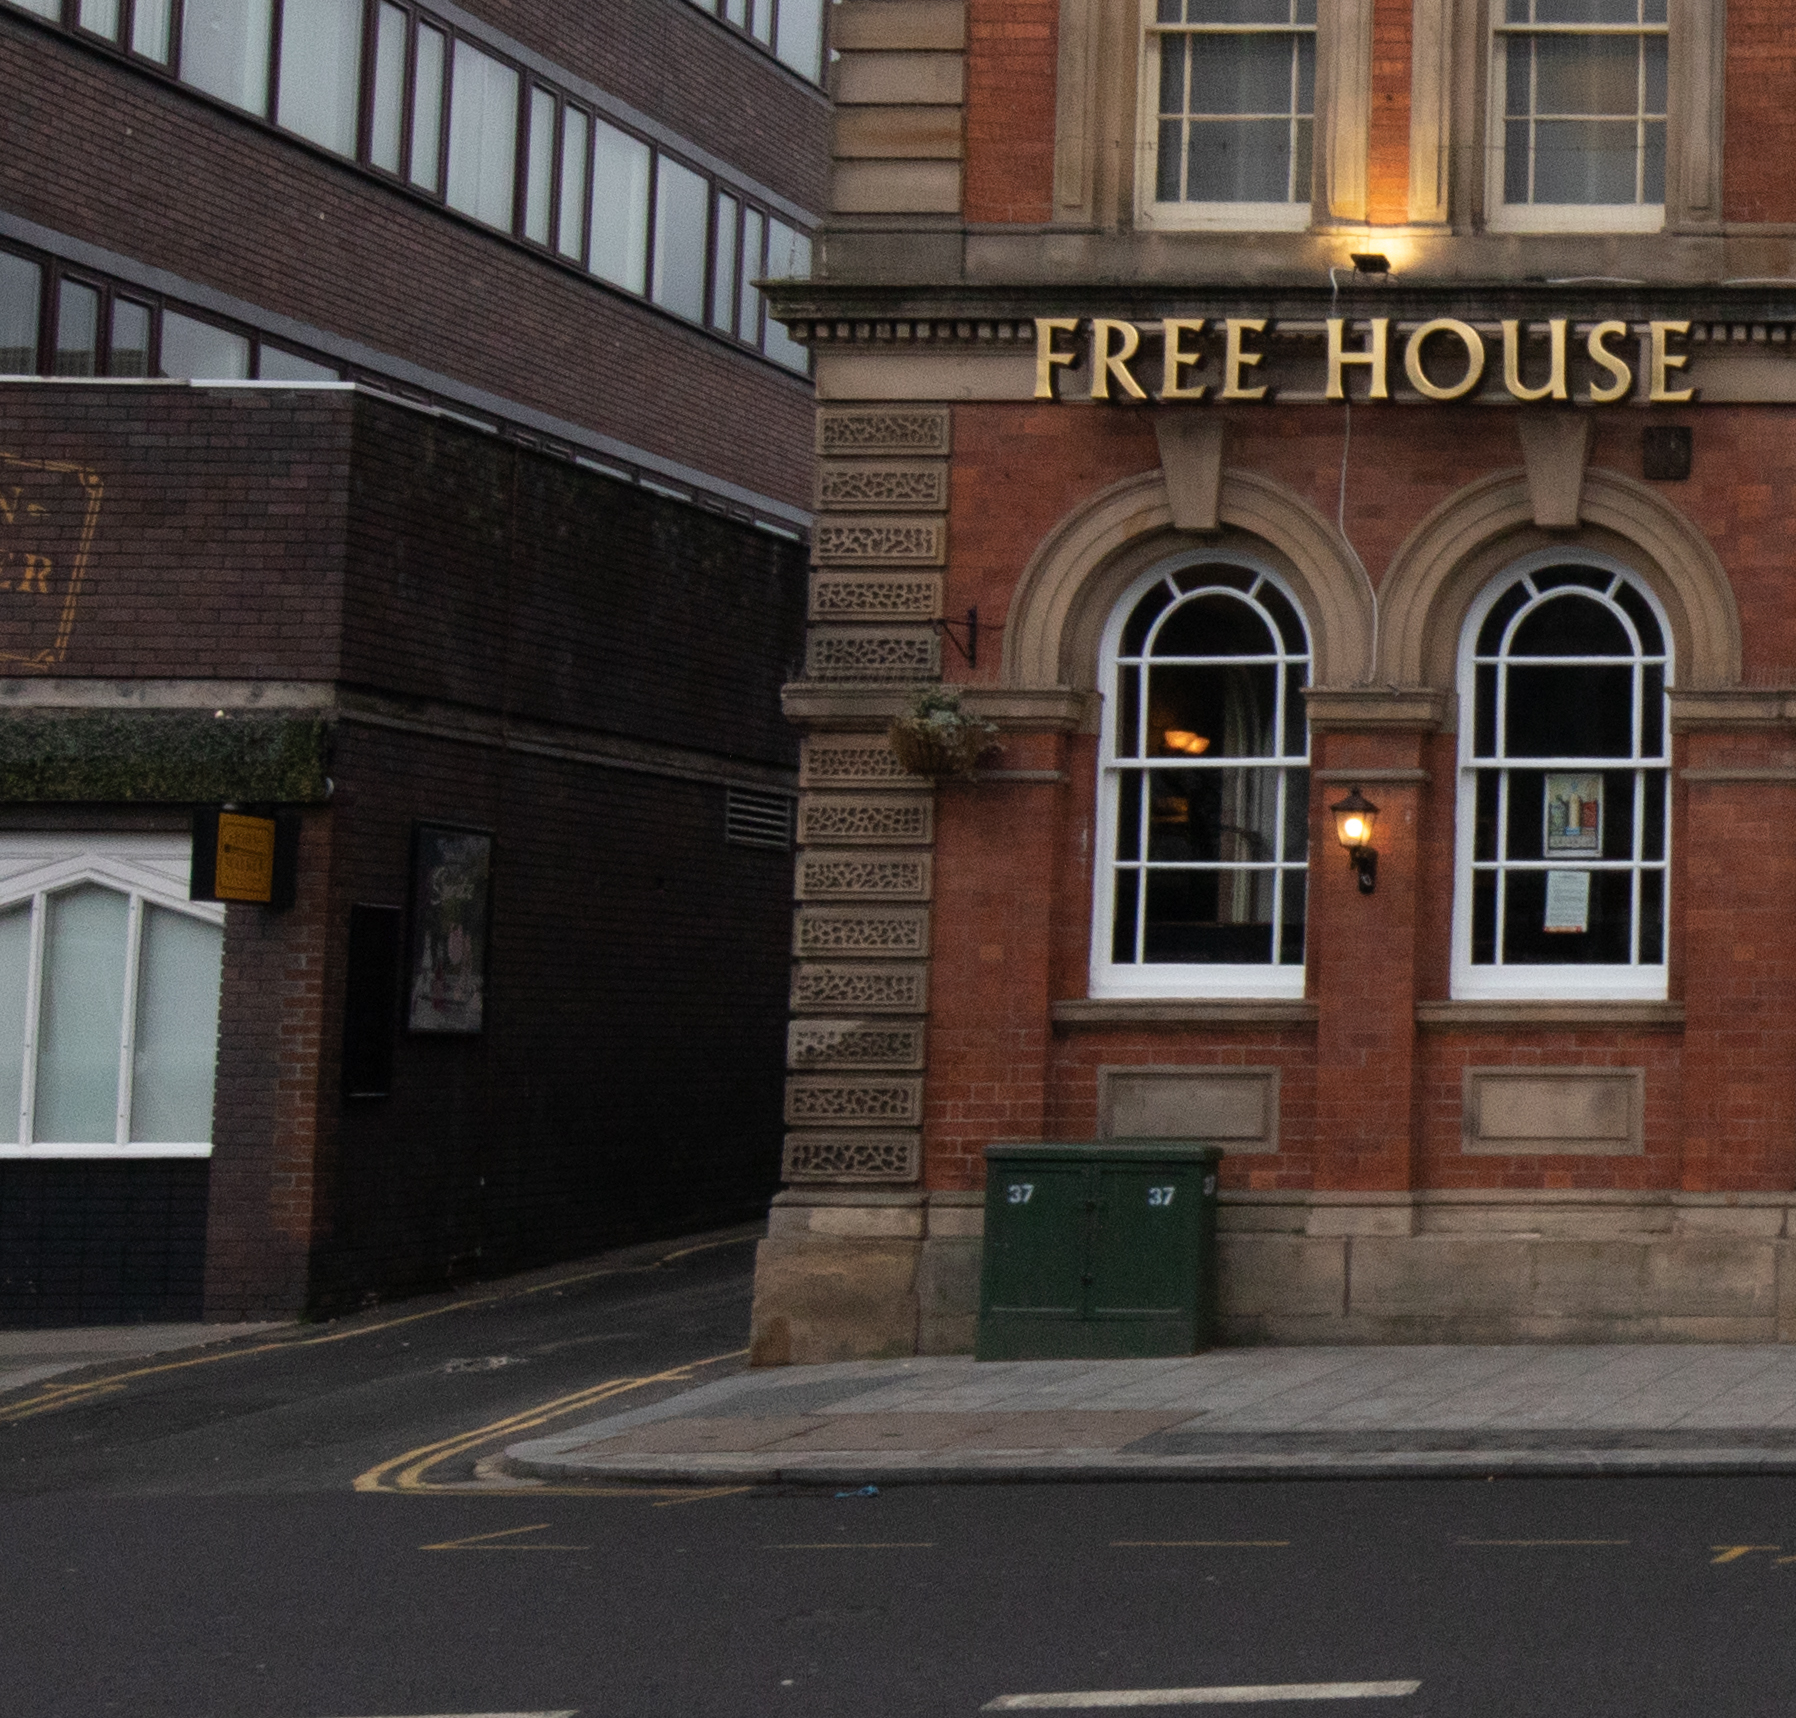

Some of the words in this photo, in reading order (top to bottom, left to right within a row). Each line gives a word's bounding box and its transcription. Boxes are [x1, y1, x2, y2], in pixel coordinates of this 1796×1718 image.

[1033, 317, 1268, 400] FREE
[1325, 317, 1697, 403] HOUSE
[1006, 1183, 1034, 1204] 37
[1148, 1186, 1175, 1206] 37
